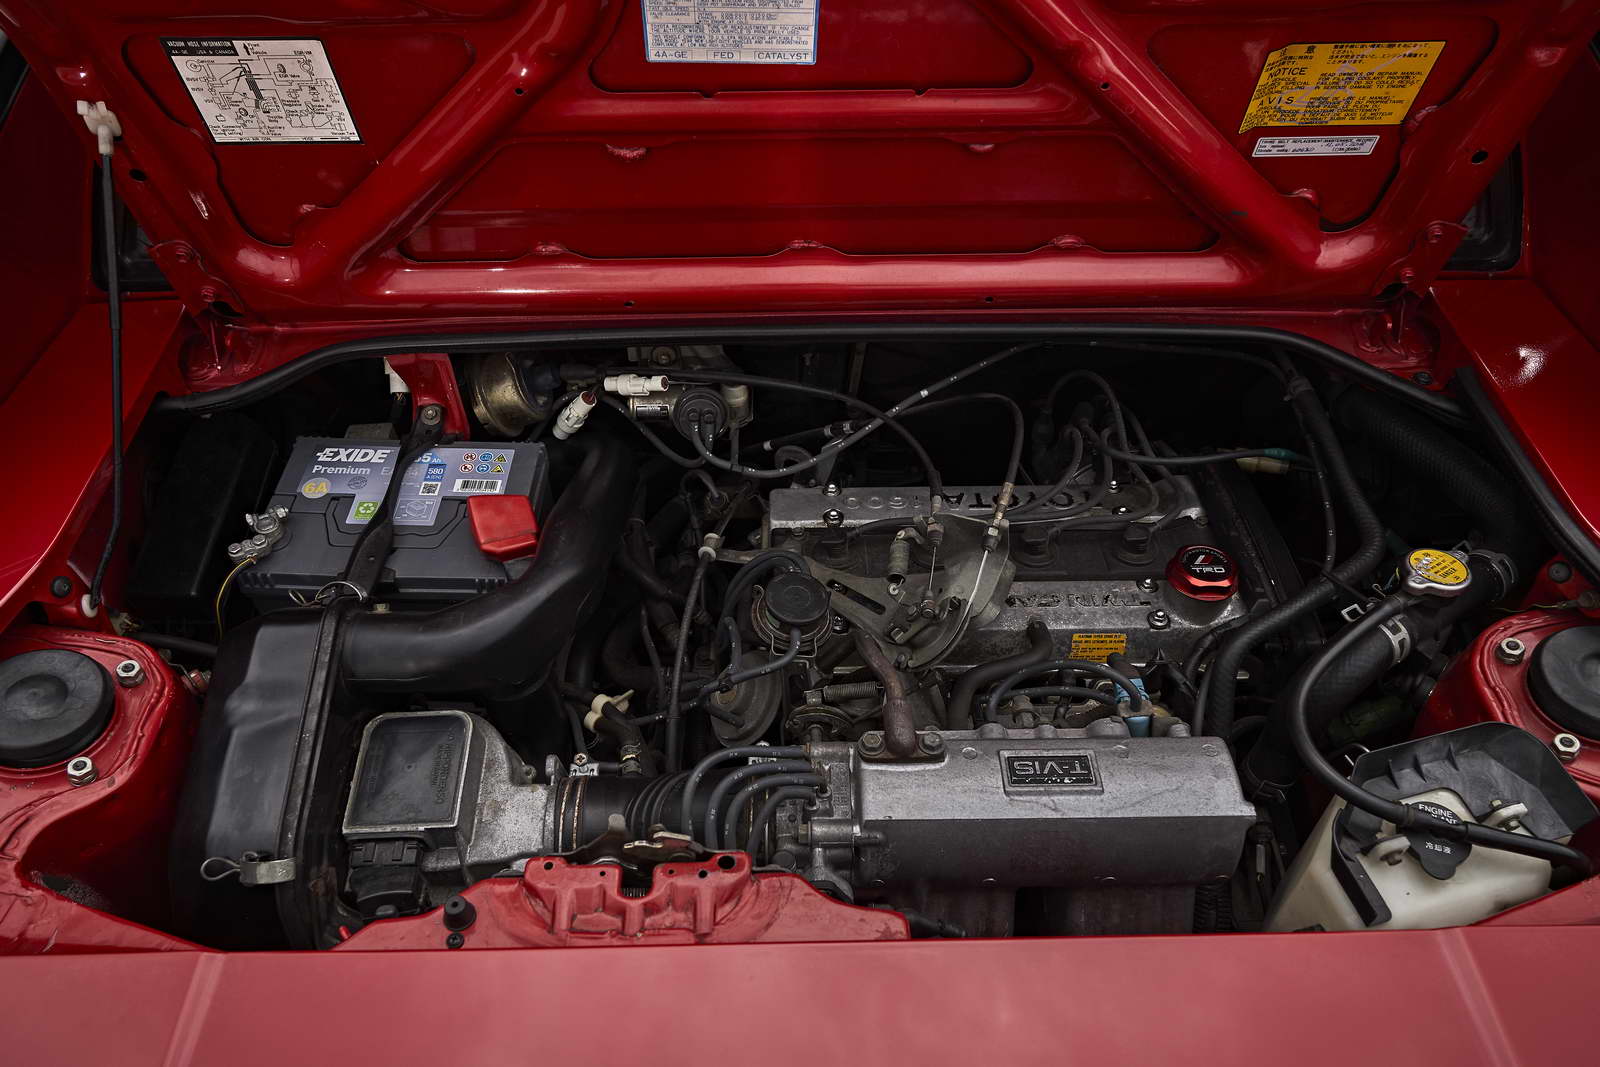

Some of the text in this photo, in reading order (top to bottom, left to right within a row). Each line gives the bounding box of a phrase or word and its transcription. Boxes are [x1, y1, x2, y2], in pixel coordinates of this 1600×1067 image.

[757, 52, 809, 60] CATALYST
[1267, 67, 1308, 80] NOTICE
[316, 448, 391, 463] EXIDE
[312, 465, 370, 475] Premium
[845, 495, 922, 509] 1600
[1066, 592, 1152, 608] TWIN
[1013, 760, 1089, 775] T-VIS
[1418, 803, 1454, 819] ENGINE
